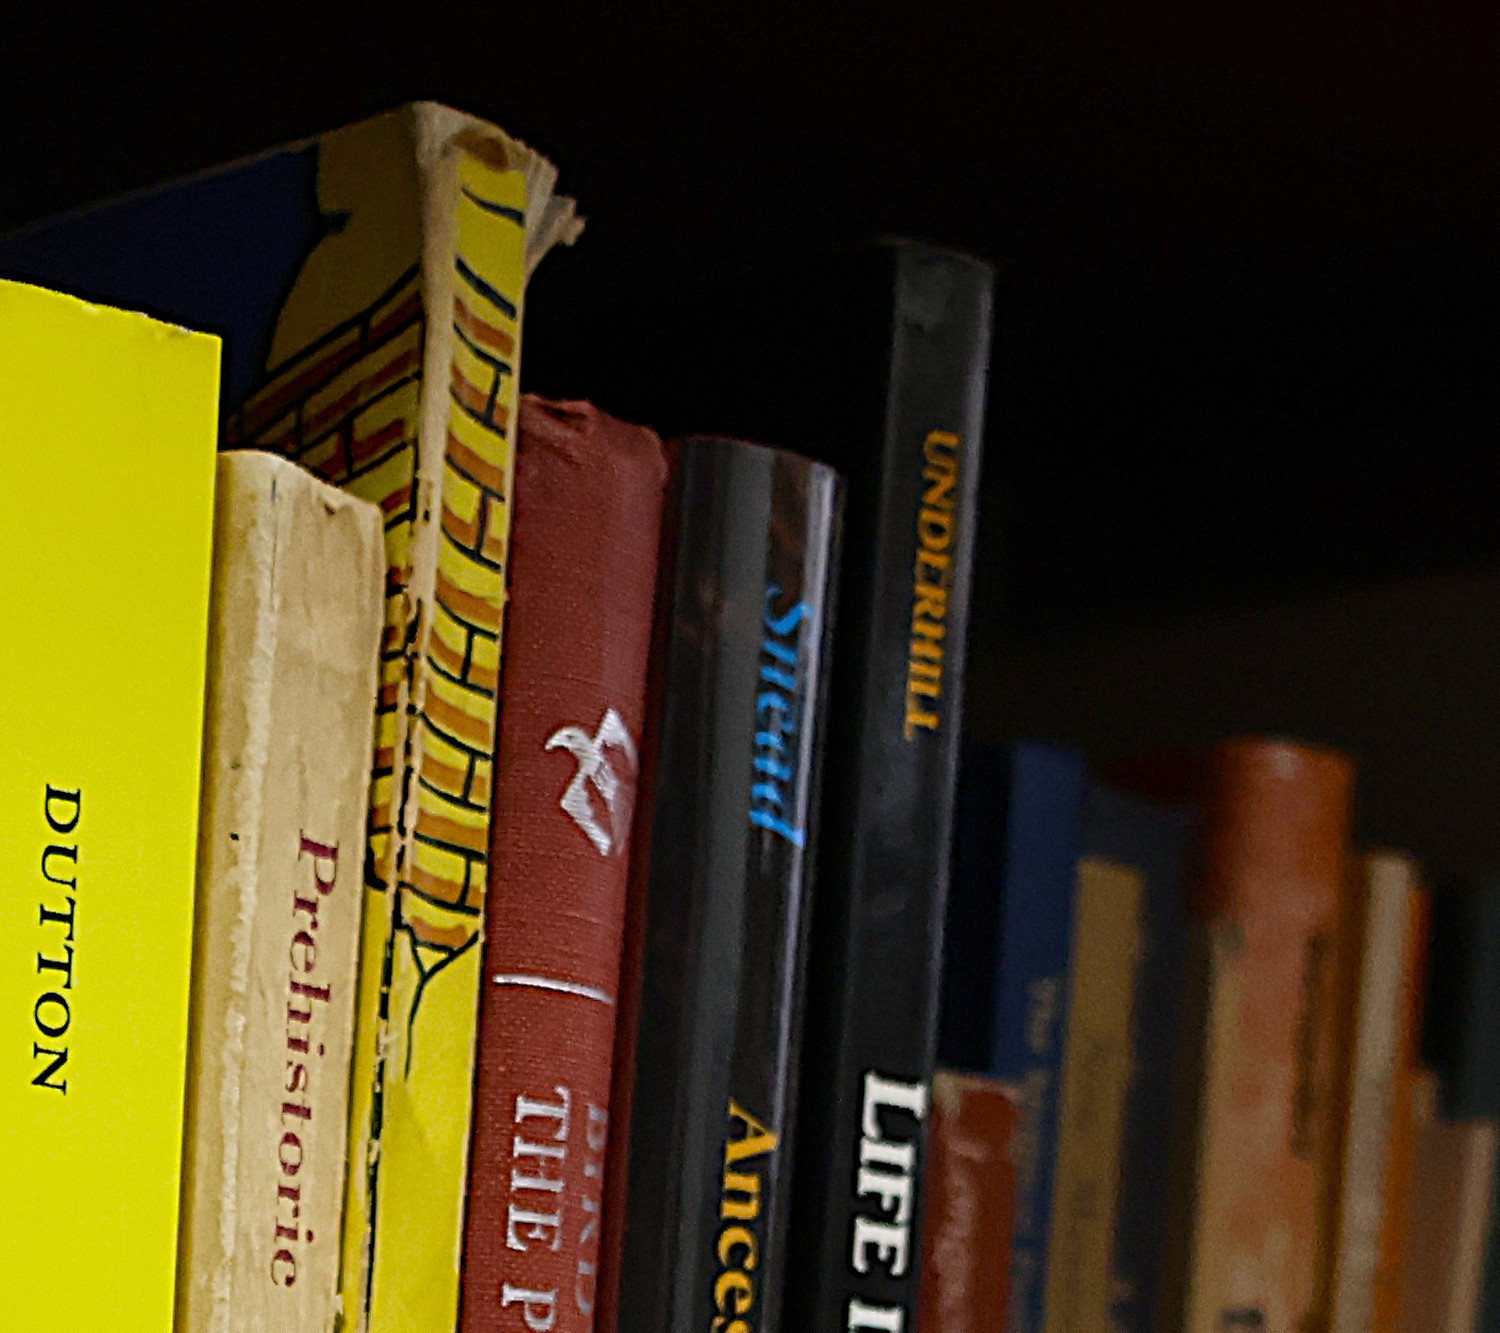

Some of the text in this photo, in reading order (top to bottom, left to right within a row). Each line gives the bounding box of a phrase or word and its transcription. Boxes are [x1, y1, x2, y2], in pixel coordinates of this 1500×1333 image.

[904, 426, 962, 741] UNDERHILL
[30, 782, 82, 1095] DUTTON
[268, 829, 340, 1289] Prehistoric
[504, 1084, 571, 1252] THE
[852, 1070, 927, 1280] LIFE
